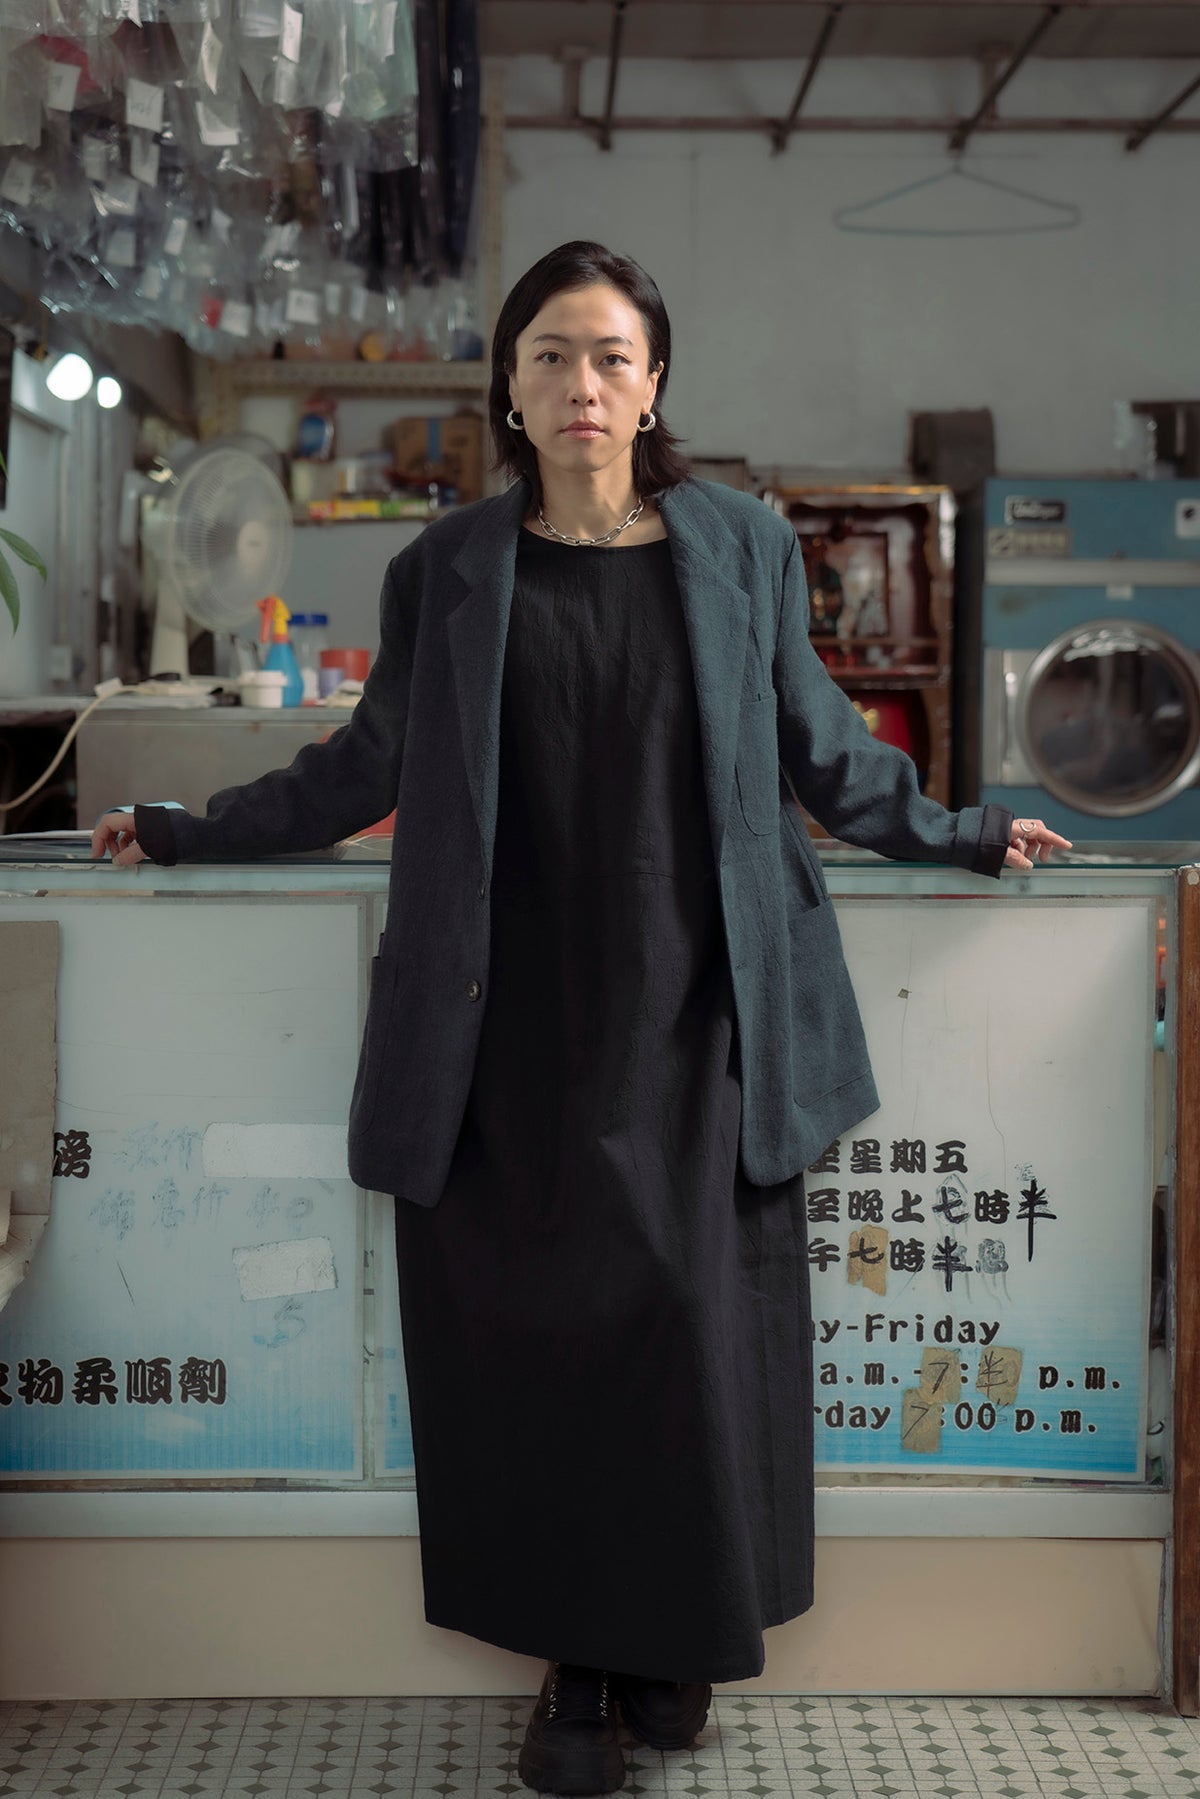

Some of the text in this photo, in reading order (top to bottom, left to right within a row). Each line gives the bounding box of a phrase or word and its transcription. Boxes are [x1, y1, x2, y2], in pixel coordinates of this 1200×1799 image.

[806, 1138, 968, 1174] 至星期五
[811, 1313, 1000, 1345] y-Friday
[0, 1356, 227, 1405] 物柔順劑
[1038, 1365, 1121, 1390] p.m.
[1014, 1408, 1097, 1434] p.m.
